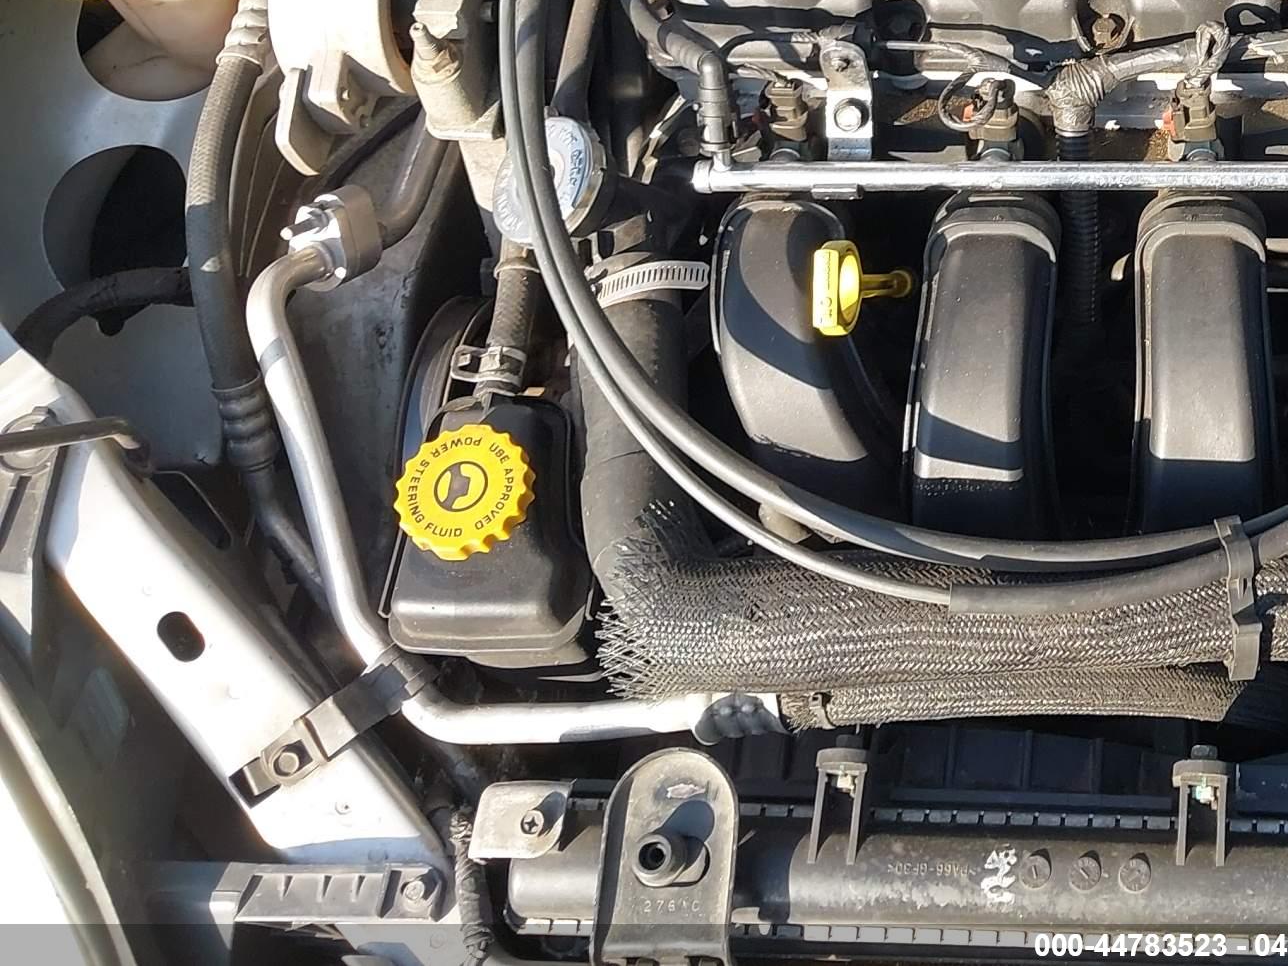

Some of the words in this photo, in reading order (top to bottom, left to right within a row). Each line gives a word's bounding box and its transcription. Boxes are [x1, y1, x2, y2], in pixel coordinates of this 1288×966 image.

[430, 436, 484, 459] POWER
[488, 443, 510, 464] USE
[406, 458, 430, 524] STEERING
[473, 467, 514, 531] APPROVED
[424, 522, 463, 538] FLUID
